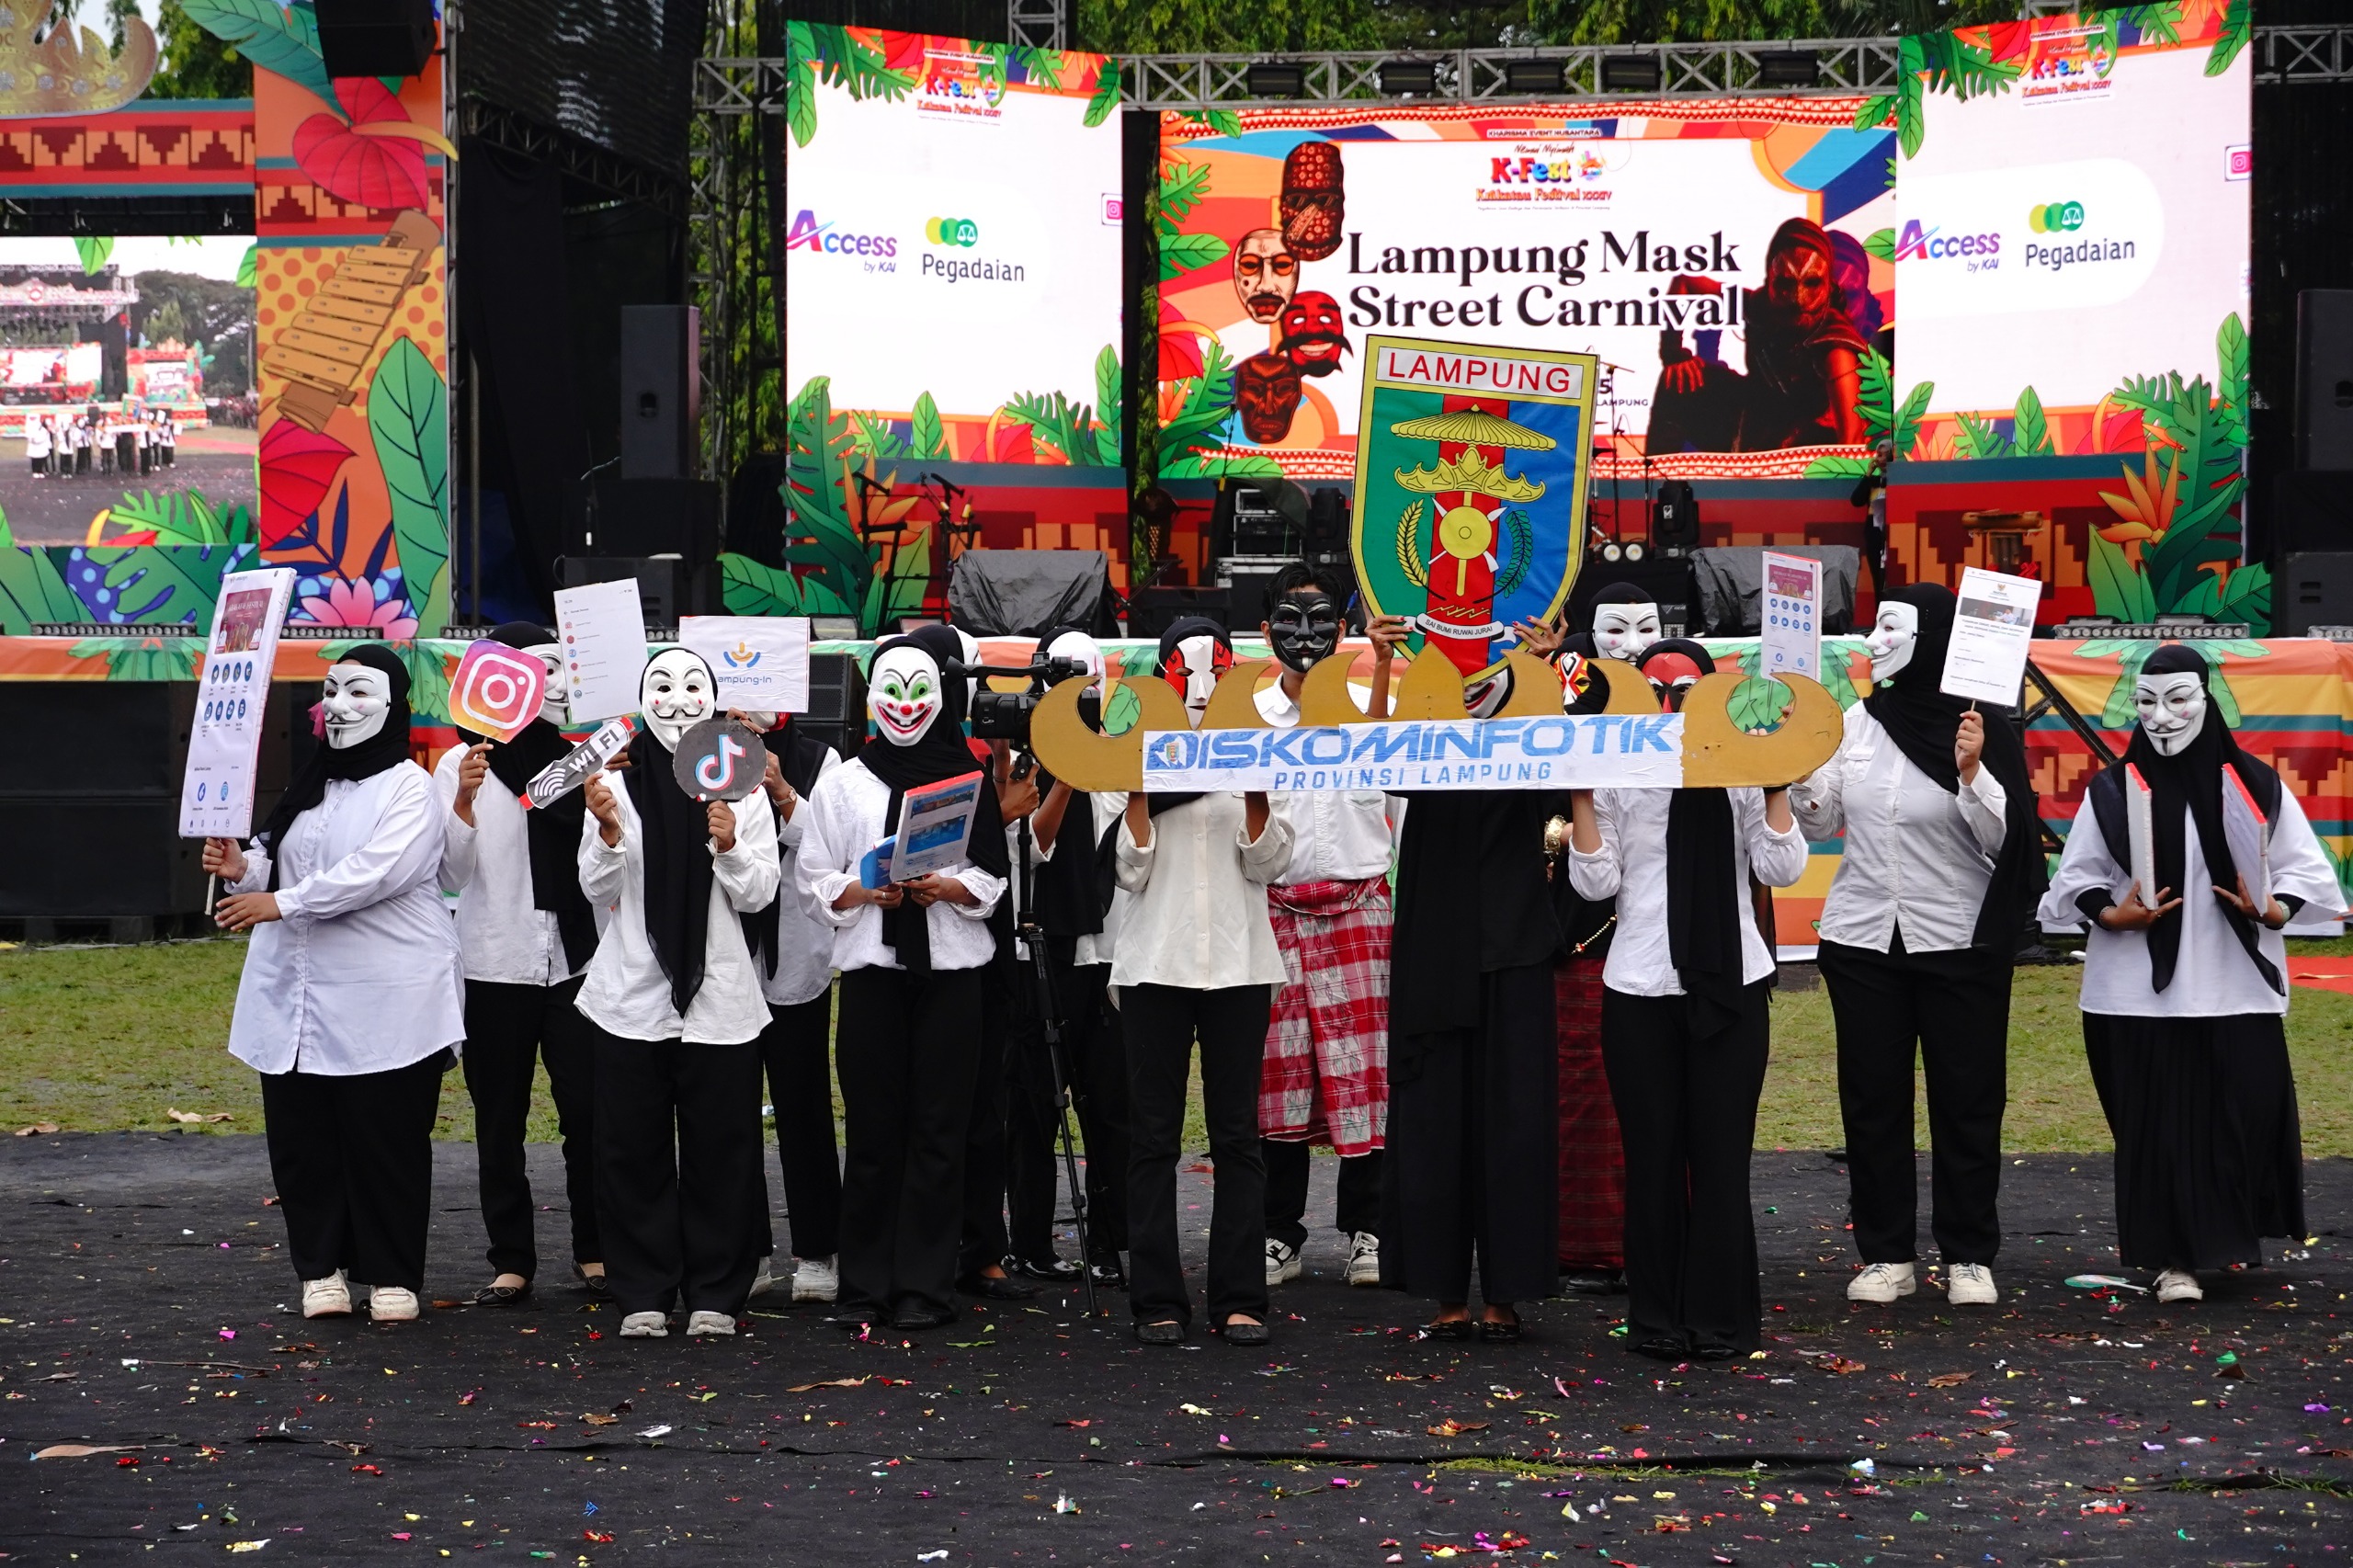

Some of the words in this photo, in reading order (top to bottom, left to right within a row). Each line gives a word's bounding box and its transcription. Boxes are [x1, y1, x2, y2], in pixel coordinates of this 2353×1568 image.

[1491, 157, 1572, 183] K-Fest
[1534, 187, 1580, 201] Festival
[787, 209, 897, 257] Access
[1895, 219, 2001, 262] Access
[863, 260, 876, 273] by
[878, 261, 896, 273] KAI
[922, 254, 1025, 283] Pegadaian
[1347, 233, 1589, 286] Lampung
[1600, 231, 1742, 274] Mask
[1967, 260, 1979, 274] by
[1981, 258, 1999, 271] KAI
[2026, 237, 2135, 271] Pegadaian
[1349, 285, 1502, 328] Street
[1517, 284, 1741, 328] Carnival
[1388, 352, 1570, 393] LAMPUNG
[1425, 619, 1436, 629] SAI
[1437, 623, 1452, 634] BUMI
[1453, 628, 1473, 636] RUWAI
[1474, 626, 1493, 636] JURAI
[718, 676, 772, 686] ampung-In
[1274, 767, 1404, 790] PROVINSI
[1421, 761, 1552, 784] LAMPUNG
